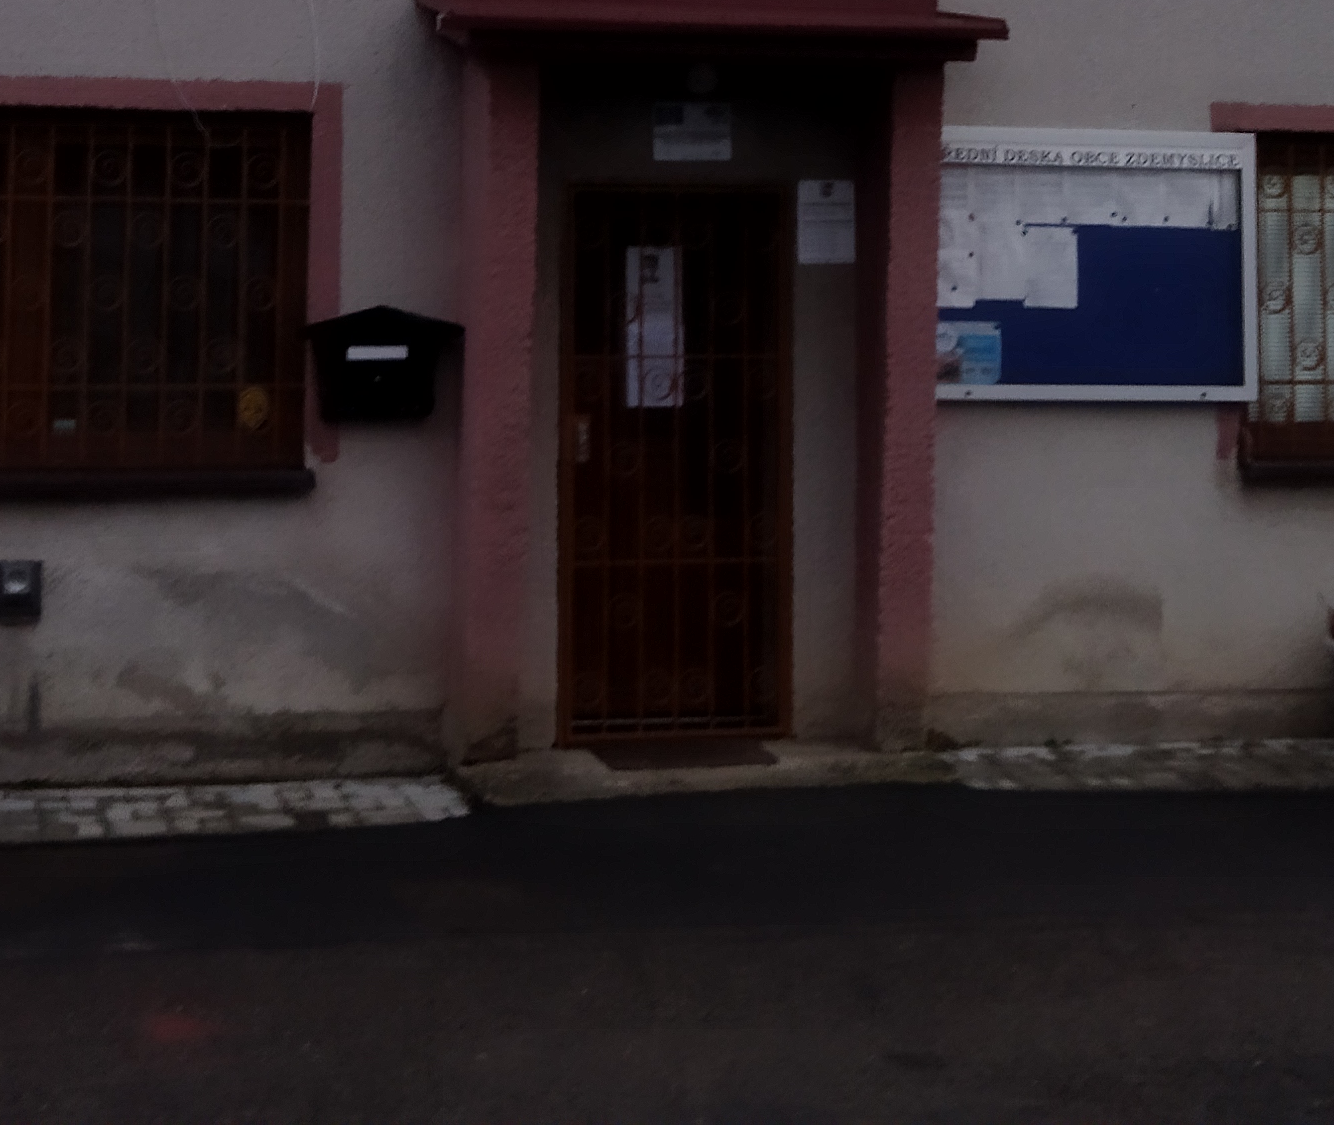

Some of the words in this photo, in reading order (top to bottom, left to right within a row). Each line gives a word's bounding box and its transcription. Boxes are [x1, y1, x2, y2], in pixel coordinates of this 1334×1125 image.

[941, 143, 1000, 163] ŘEDNÍ
[1004, 147, 1064, 164] DESKA
[1070, 150, 1121, 166] OBCE
[1125, 151, 1241, 168] ZDEMYSLICE
